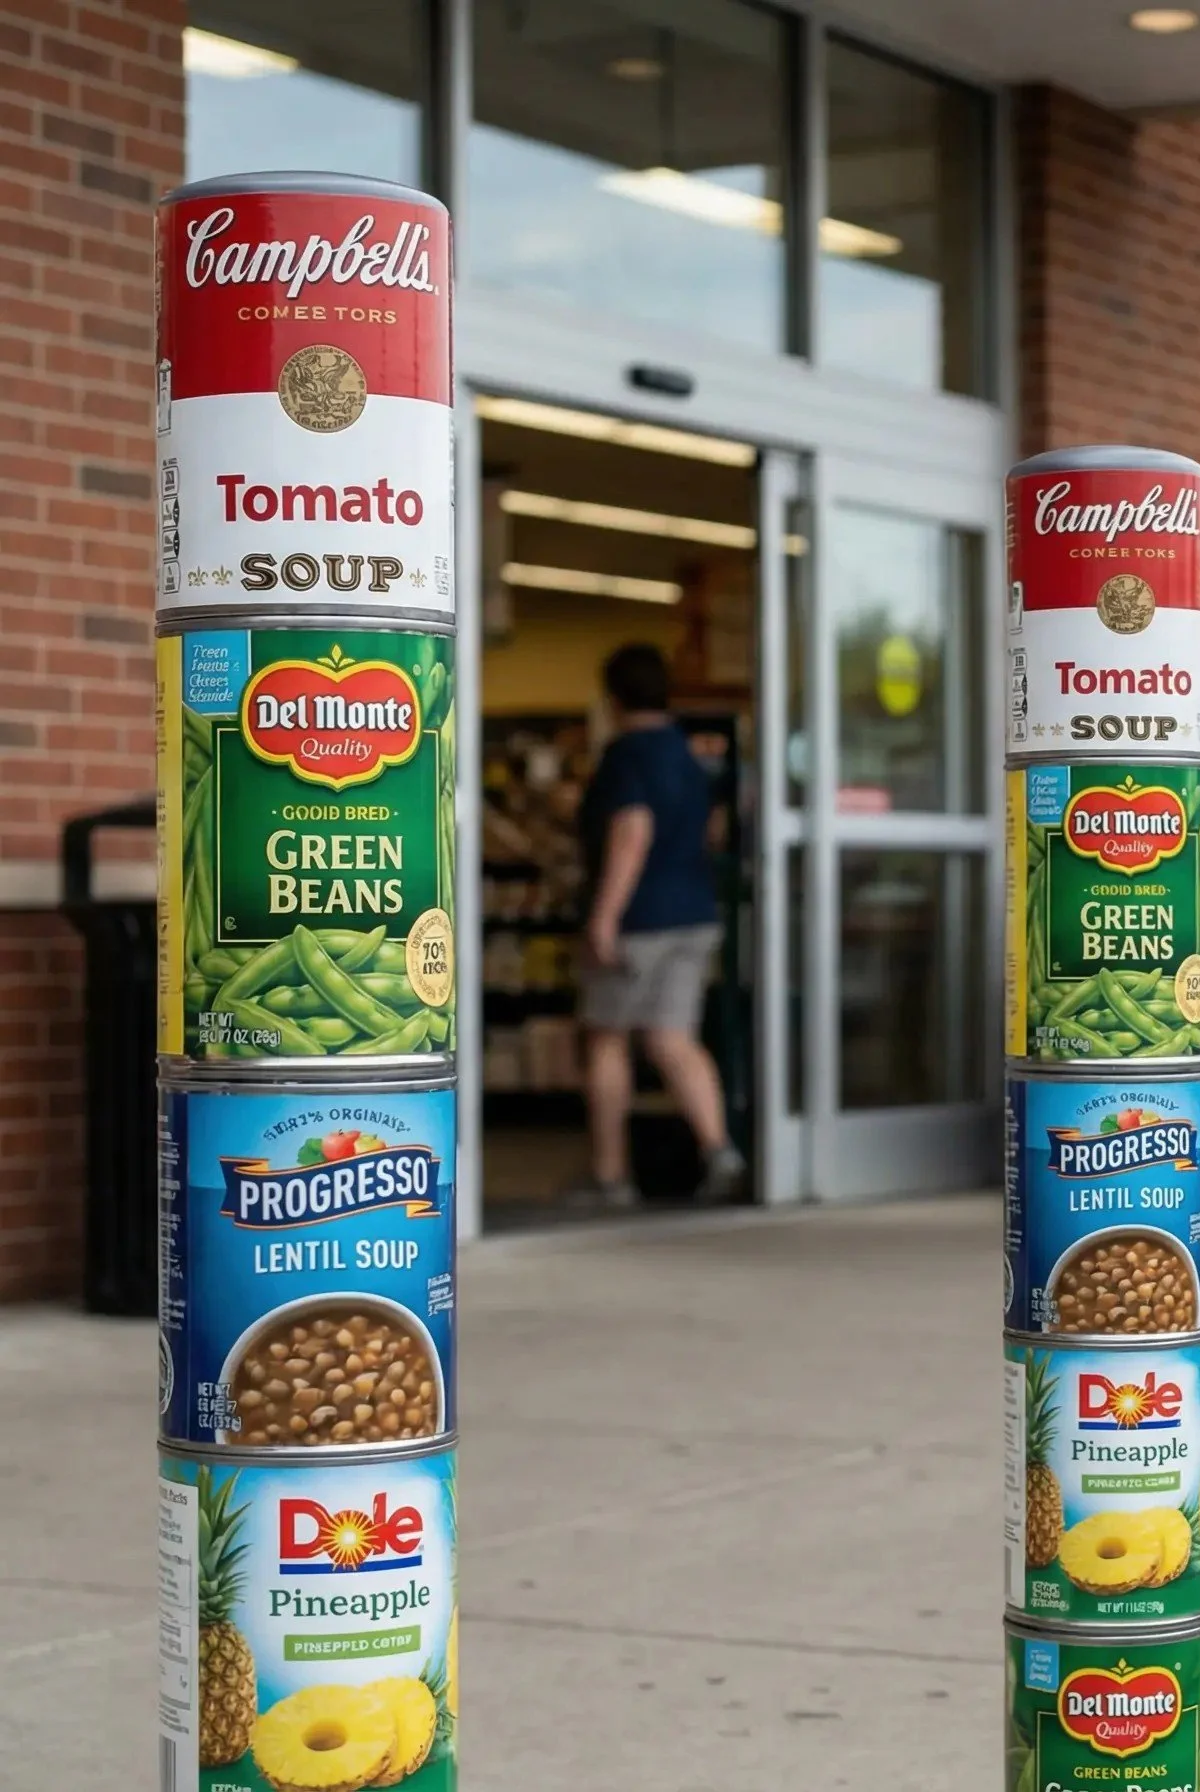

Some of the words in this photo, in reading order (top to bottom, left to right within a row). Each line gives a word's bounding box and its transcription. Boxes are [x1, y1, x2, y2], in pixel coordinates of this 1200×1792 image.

[186, 207, 440, 298] Campbell's
[216, 474, 424, 526] Tomato
[1034, 481, 1200, 542] Campbell's
[240, 553, 404, 592] SOUP
[1054, 661, 1192, 696] Tomato
[256, 695, 309, 730] Del
[313, 695, 412, 731] Monte
[1070, 714, 1178, 741] SOUP
[300, 738, 373, 761] Quality
[345, 805, 390, 820] BRED
[1074, 810, 1110, 835] Del
[1113, 810, 1181, 835] Monte
[266, 829, 403, 871] GREEN
[268, 874, 404, 915] BEANS
[1080, 901, 1174, 930] GREEN
[1082, 932, 1174, 960] BEANS
[1060, 1127, 1191, 1173] PROGRESSO
[239, 1156, 429, 1221] PROGRESSO
[1069, 1187, 1134, 1212] LENTIL
[1139, 1186, 1185, 1210] SOUP
[254, 1240, 347, 1274] LENTIL
[355, 1239, 419, 1270] SOUP
[1079, 1372, 1183, 1422] Dole
[1071, 1437, 1189, 1466] Pineapple
[279, 1492, 423, 1565] Dole
[268, 1580, 431, 1620] Pineapple
[1067, 1691, 1104, 1717] Del
[1106, 1690, 1176, 1717] Monte
[1073, 1766, 1121, 1780] GREEN
[1124, 1763, 1168, 1779] BEANS
